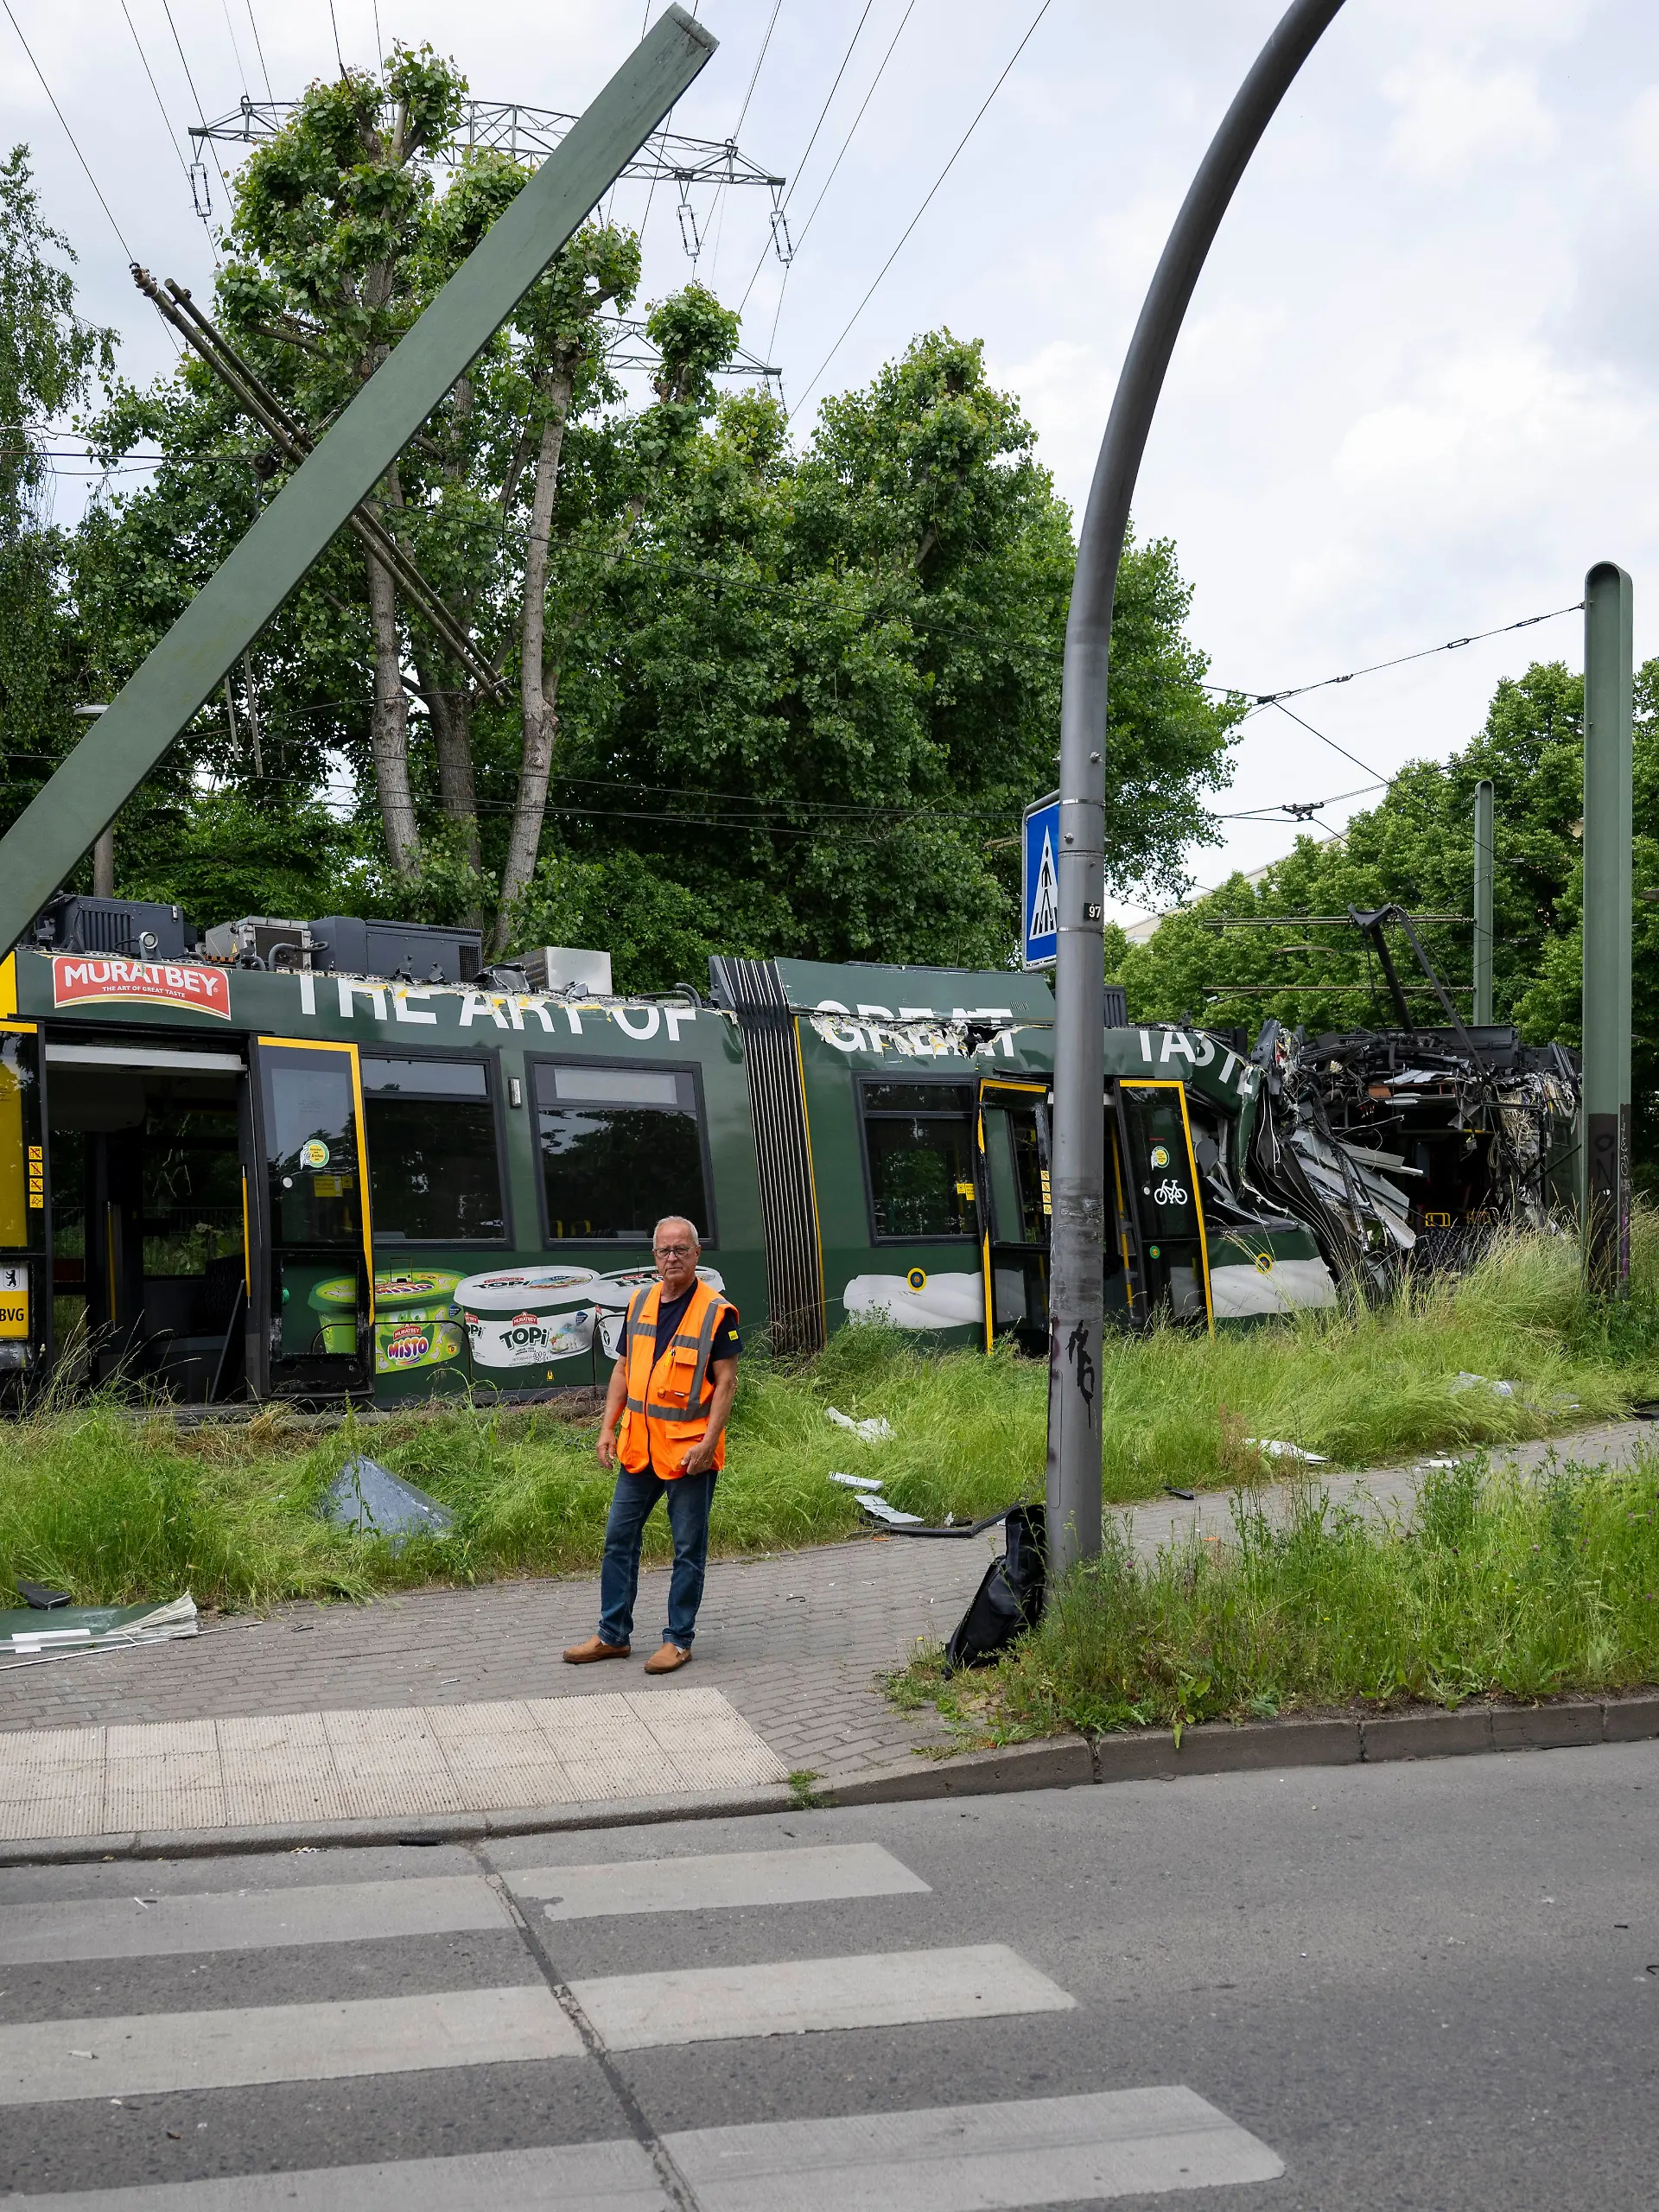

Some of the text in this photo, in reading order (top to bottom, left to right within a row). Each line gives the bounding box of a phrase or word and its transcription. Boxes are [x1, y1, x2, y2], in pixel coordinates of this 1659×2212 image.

[1089, 906, 1101, 918] 97
[64, 962, 219, 996] MURATBEY
[164, 988, 186, 998] TASTE
[0, 1308, 24, 1322] BVG
[394, 1327, 420, 1338] MURATBEY
[499, 1327, 549, 1350] TOPi
